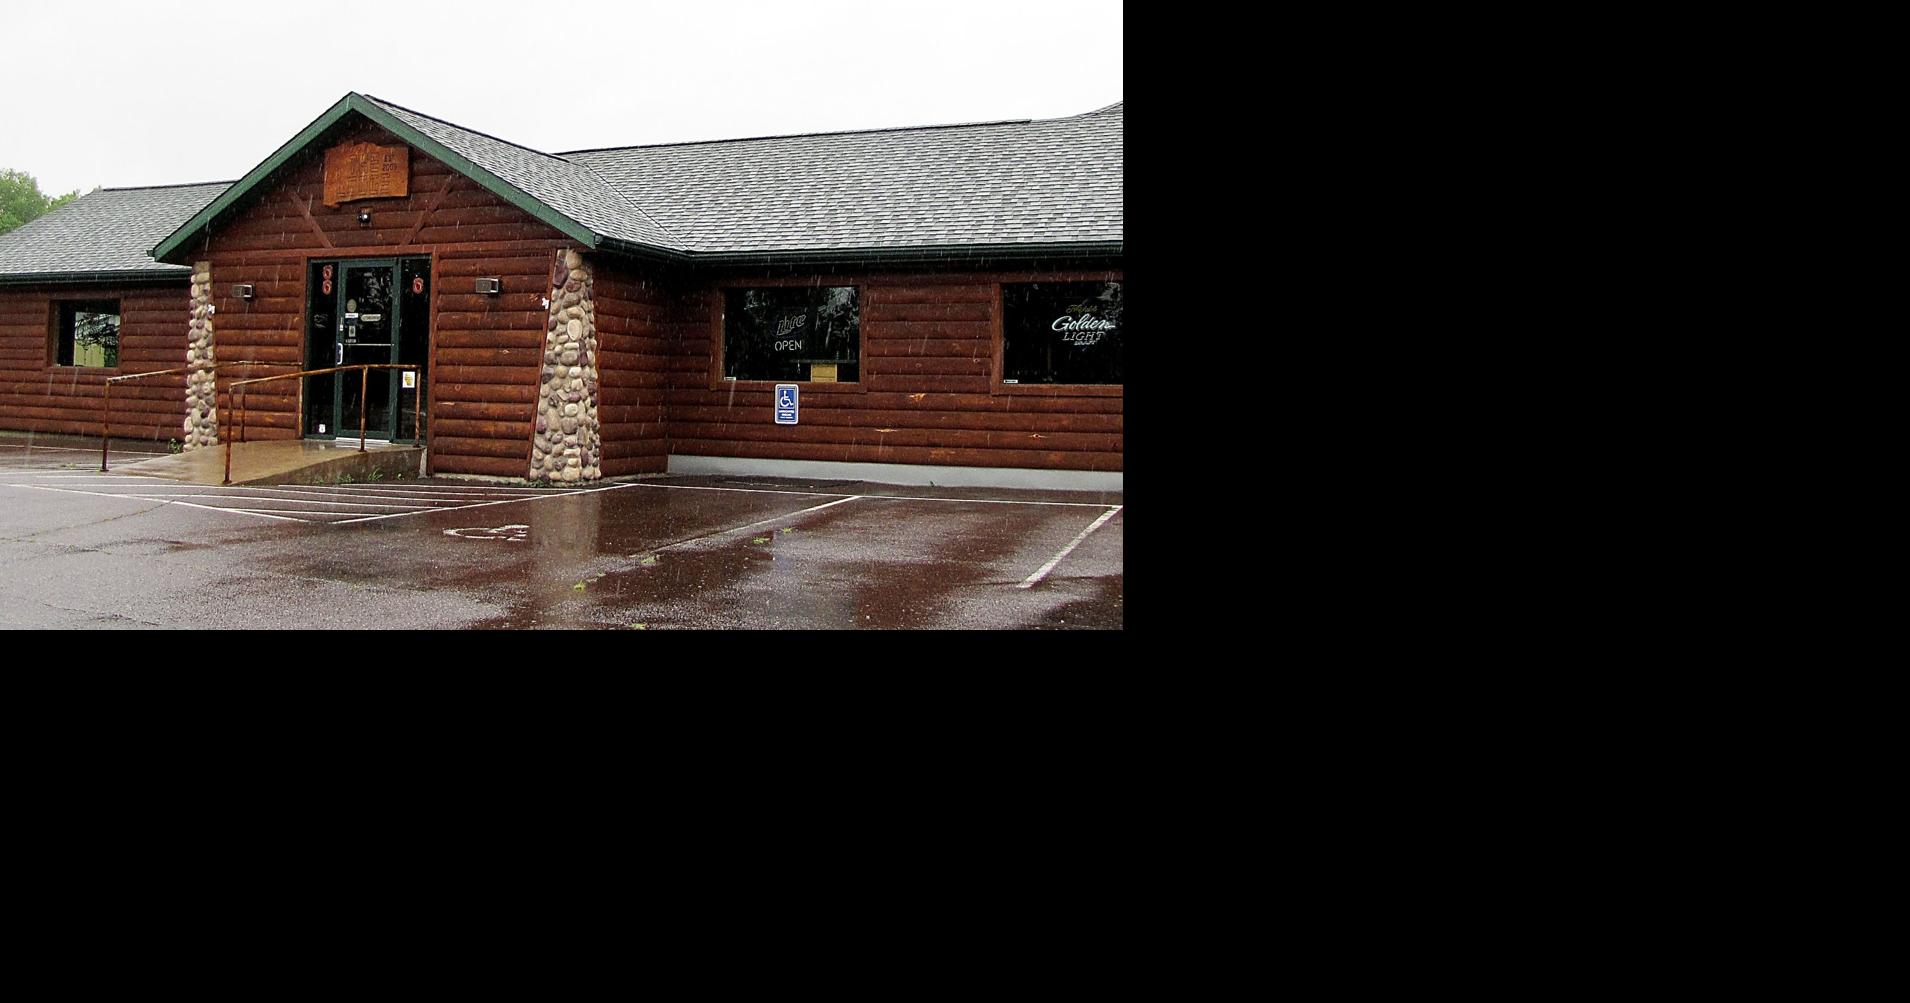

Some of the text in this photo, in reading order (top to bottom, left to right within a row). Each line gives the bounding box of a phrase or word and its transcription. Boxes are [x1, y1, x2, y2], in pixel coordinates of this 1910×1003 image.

[1051, 313, 1116, 331] Golden
[1062, 331, 1105, 341] LIGHT
[774, 339, 802, 351] OPEN
